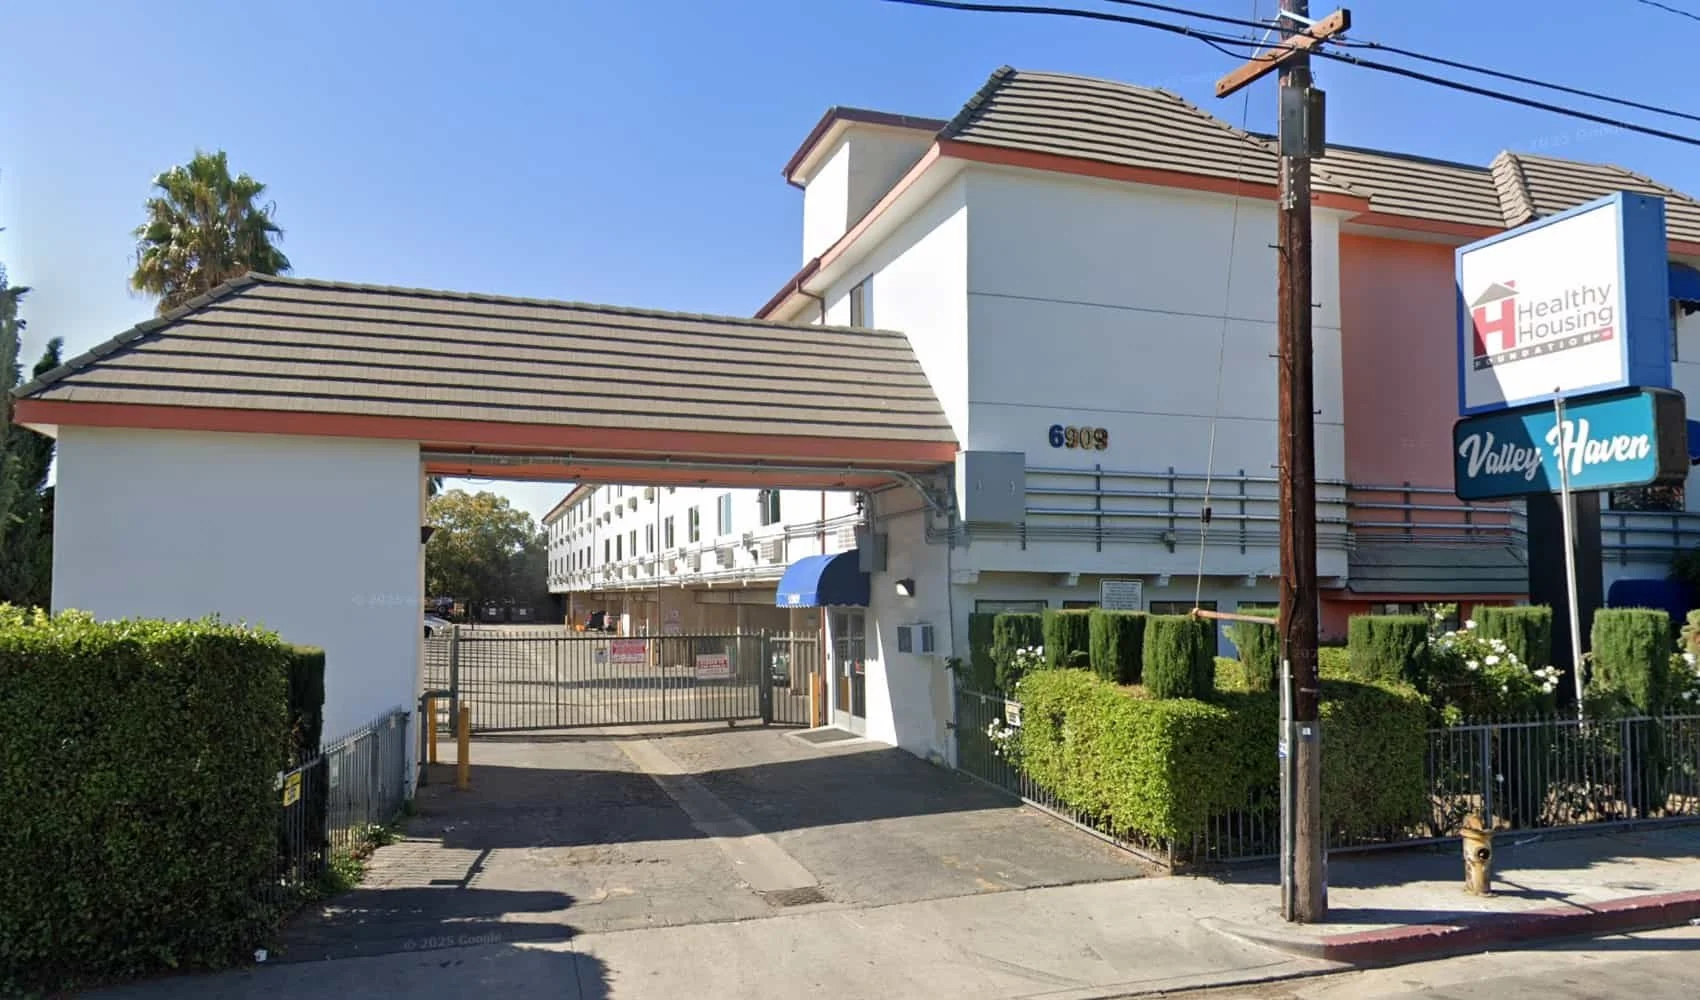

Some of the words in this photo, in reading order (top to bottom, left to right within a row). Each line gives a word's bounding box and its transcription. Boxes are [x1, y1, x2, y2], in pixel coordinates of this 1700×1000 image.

[1518, 284, 1611, 322] Healthy
[1519, 305, 1613, 341] Housing
[1475, 333, 1592, 369] FOUNDATION
[1048, 424, 1108, 450] 6909
[1458, 431, 1543, 481] Valley
[1545, 418, 1651, 476] Haven
